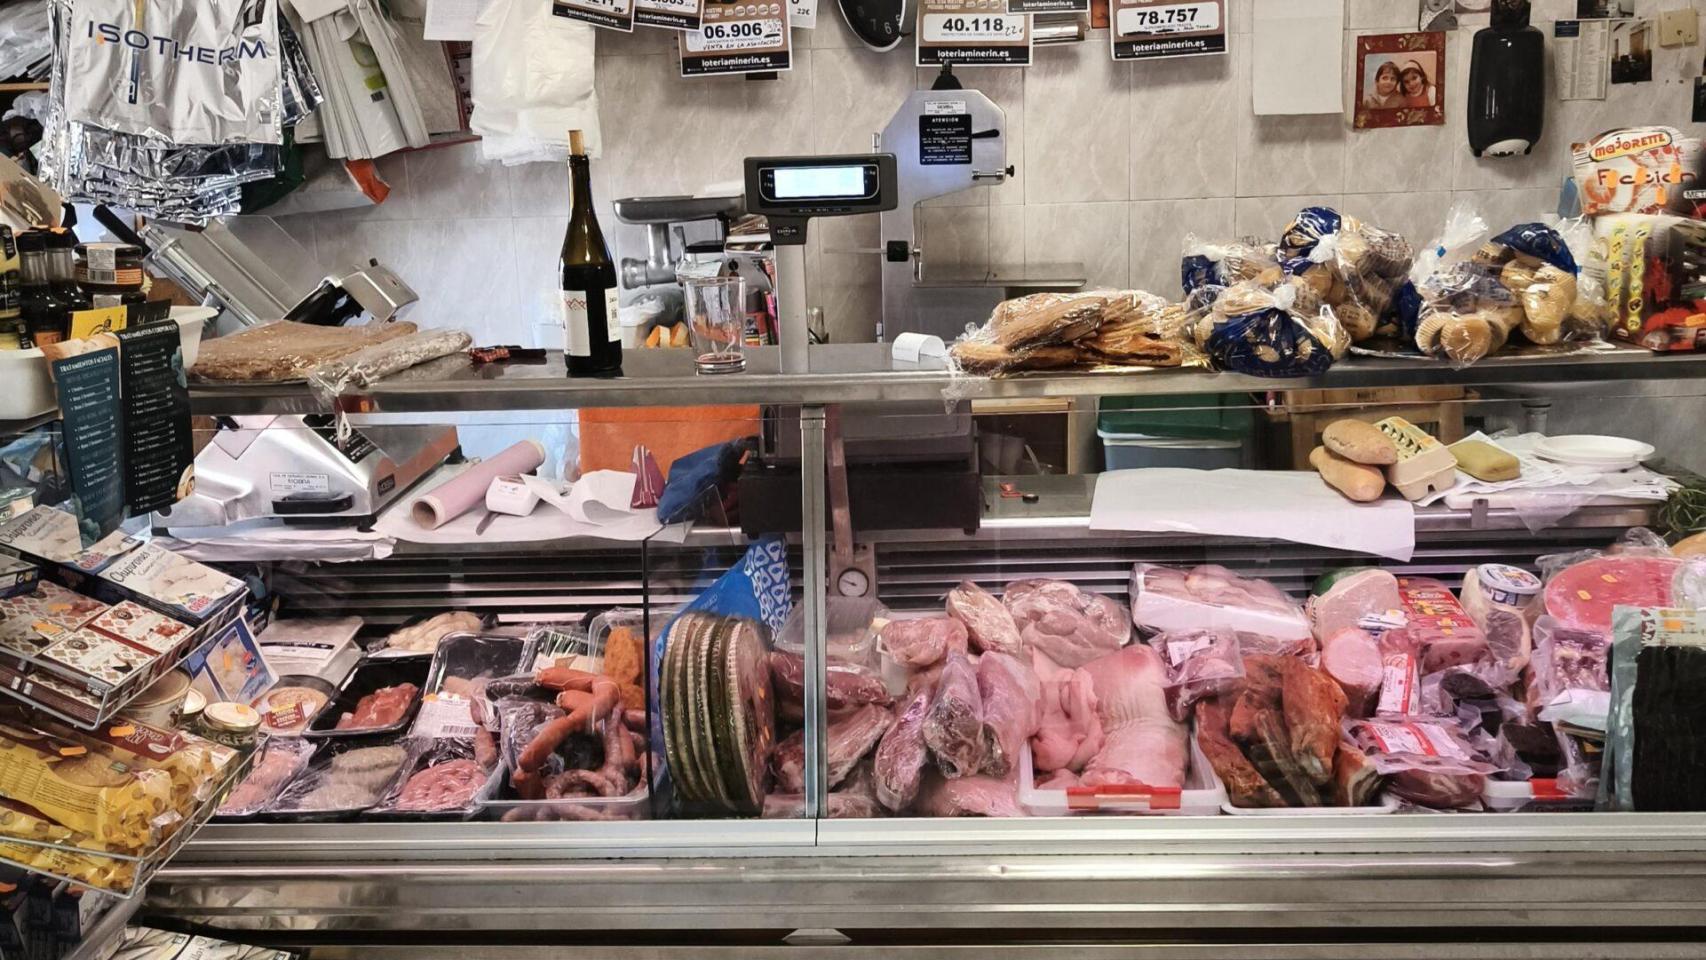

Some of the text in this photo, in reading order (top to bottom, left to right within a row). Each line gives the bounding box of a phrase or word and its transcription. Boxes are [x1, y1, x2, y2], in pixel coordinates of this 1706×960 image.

[1137, 8, 1199, 26] 78.757
[704, 23, 763, 39] 06.906
[884, 22, 892, 35] 6
[943, 18, 1003, 32] 40.118
[88, 20, 268, 66] ISOTHERM
[1132, 40, 1205, 52] loteriaminerin.es
[937, 50, 1010, 58] loteriaminerin.es
[702, 56, 771, 67] loteriaminerin.es
